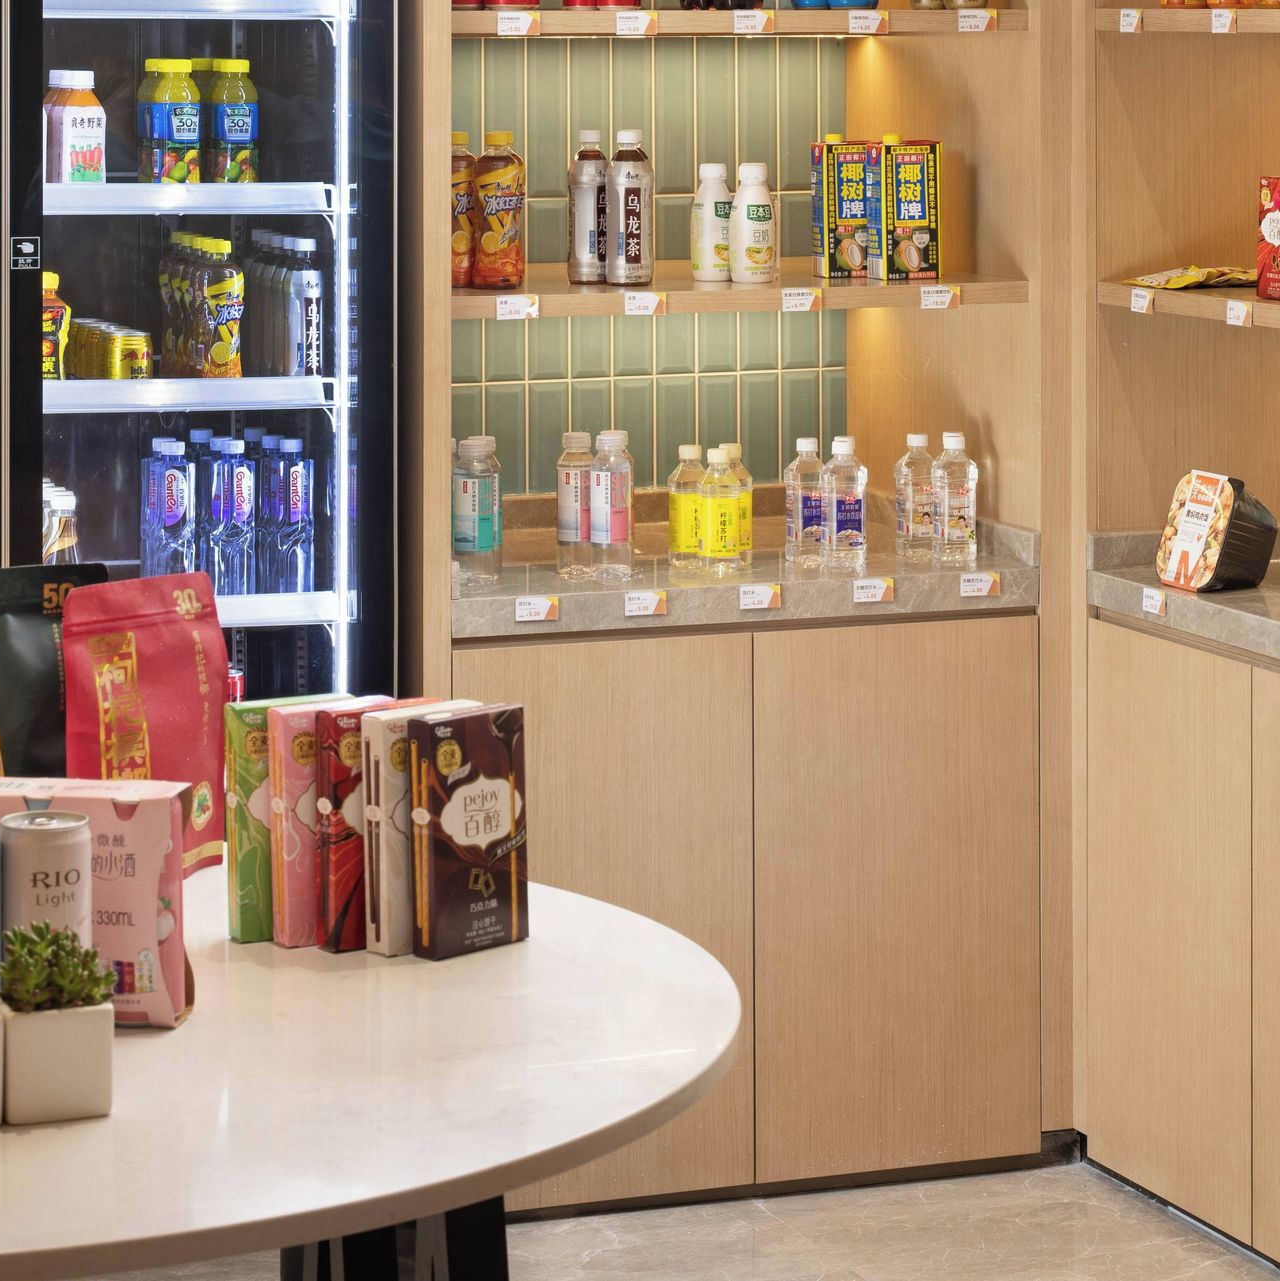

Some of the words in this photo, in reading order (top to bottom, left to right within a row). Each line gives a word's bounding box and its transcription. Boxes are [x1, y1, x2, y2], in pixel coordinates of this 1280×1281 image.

[839, 162, 866, 219] 椰树牌
[897, 164, 923, 221] 椰树牌
[625, 192, 641, 257] 乌龙茶
[748, 206, 771, 218] 豆本豆
[463, 788, 500, 813] pejoy
[464, 809, 502, 839] 百醇
[30, 869, 81, 890] RIO
[36, 890, 77, 908] Light
